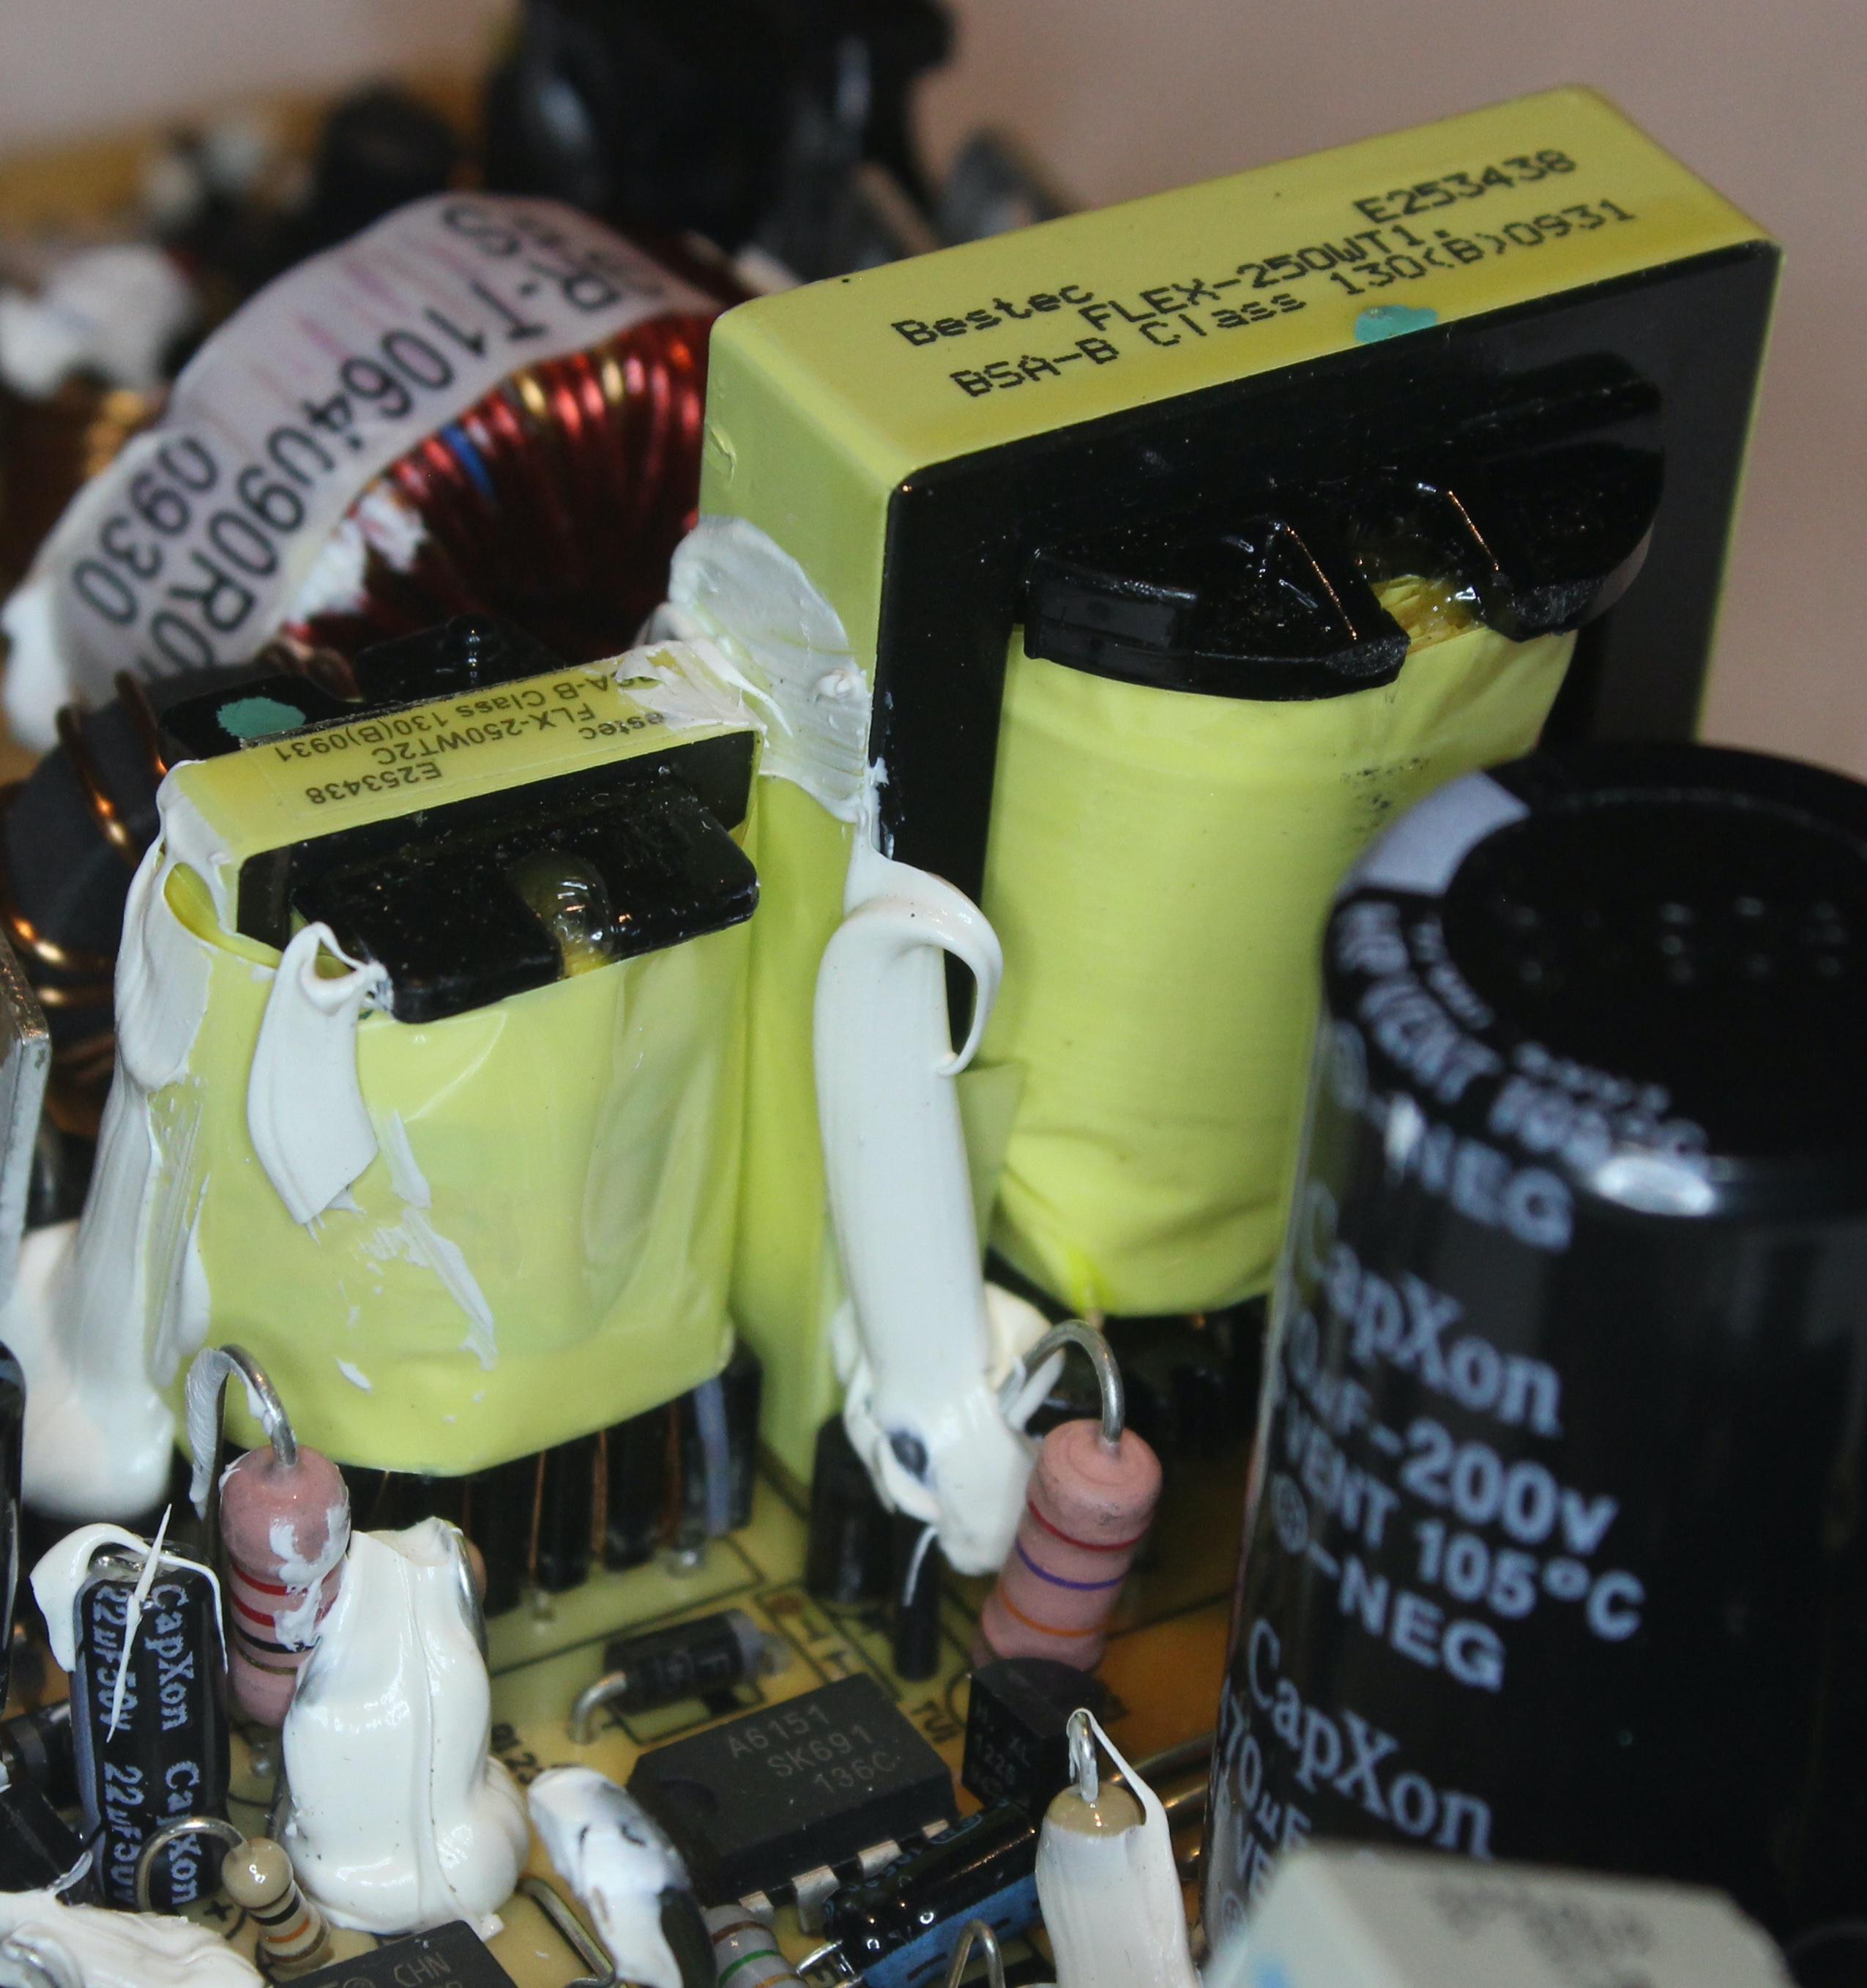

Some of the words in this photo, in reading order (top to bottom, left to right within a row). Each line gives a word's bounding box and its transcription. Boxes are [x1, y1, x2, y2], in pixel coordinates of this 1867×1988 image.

[1353, 149, 1576, 223] E253438
[891, 283, 1097, 347] Bestec
[949, 337, 1119, 396] BSA-B
[1139, 294, 1308, 347] Class
[1330, 196, 1636, 297] 130(B)0931
[72, 438, 217, 628] 0930
[455, 689, 548, 719] Class
[583, 712, 665, 741] estec
[275, 712, 447, 762] 130(B)0931
[372, 703, 597, 765] FLX-250WT2C
[305, 761, 443, 805] E253438
[146, 1583, 194, 1731] CapXon
[728, 1703, 831, 1758] A6151
[767, 1724, 875, 1779] SK691
[1248, 1618, 1494, 1860] CapXon
[393, 1953, 452, 1987] CHN
